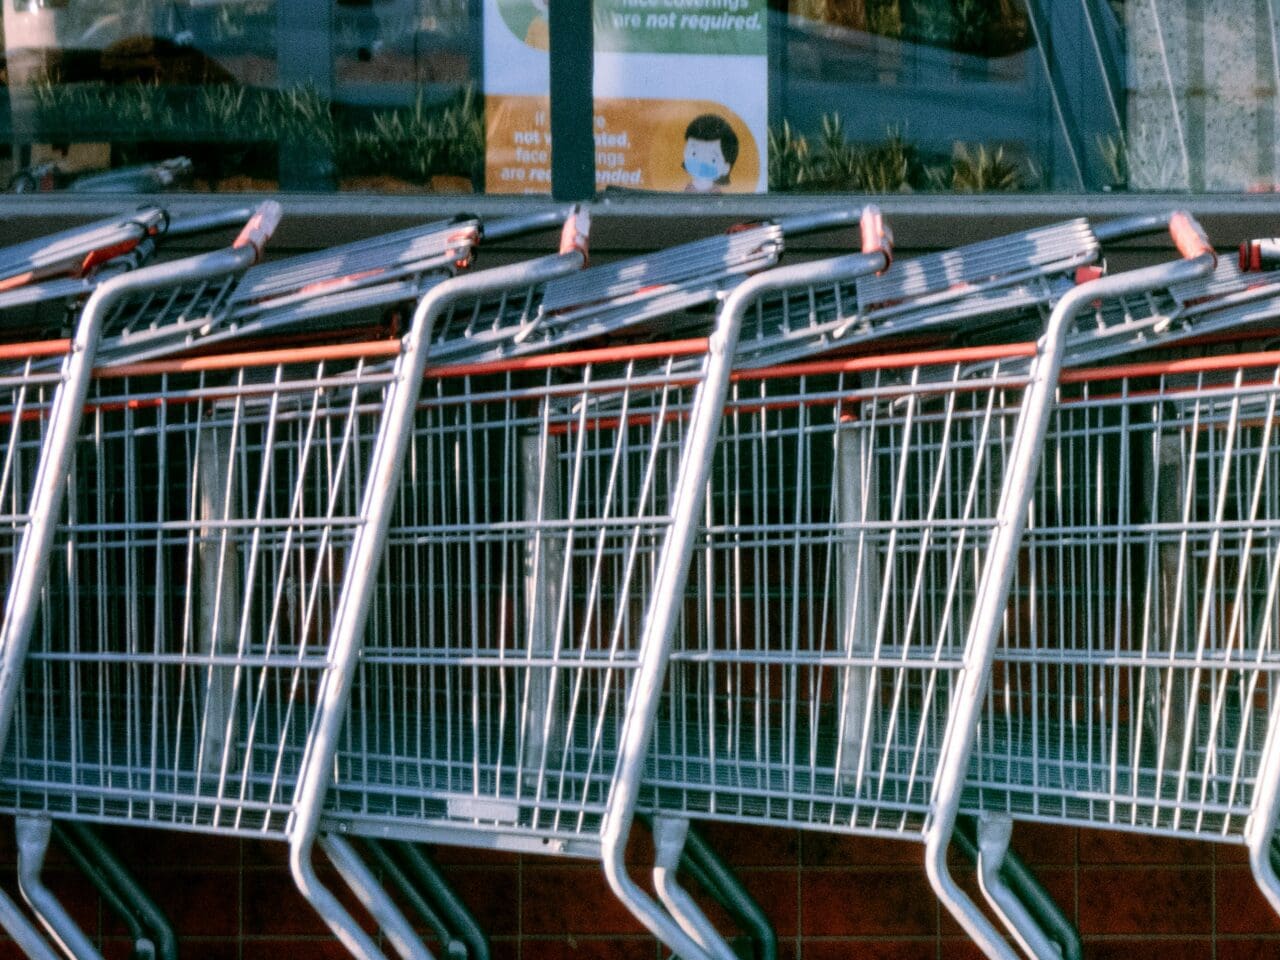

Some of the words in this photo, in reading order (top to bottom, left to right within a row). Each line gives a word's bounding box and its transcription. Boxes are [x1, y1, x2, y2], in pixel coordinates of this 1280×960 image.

[613, 14, 641, 28] are
[646, 12, 676, 29] not
[680, 12, 761, 32] required.
[514, 131, 541, 145] not
[515, 147, 548, 164] face
[501, 168, 525, 181] are
